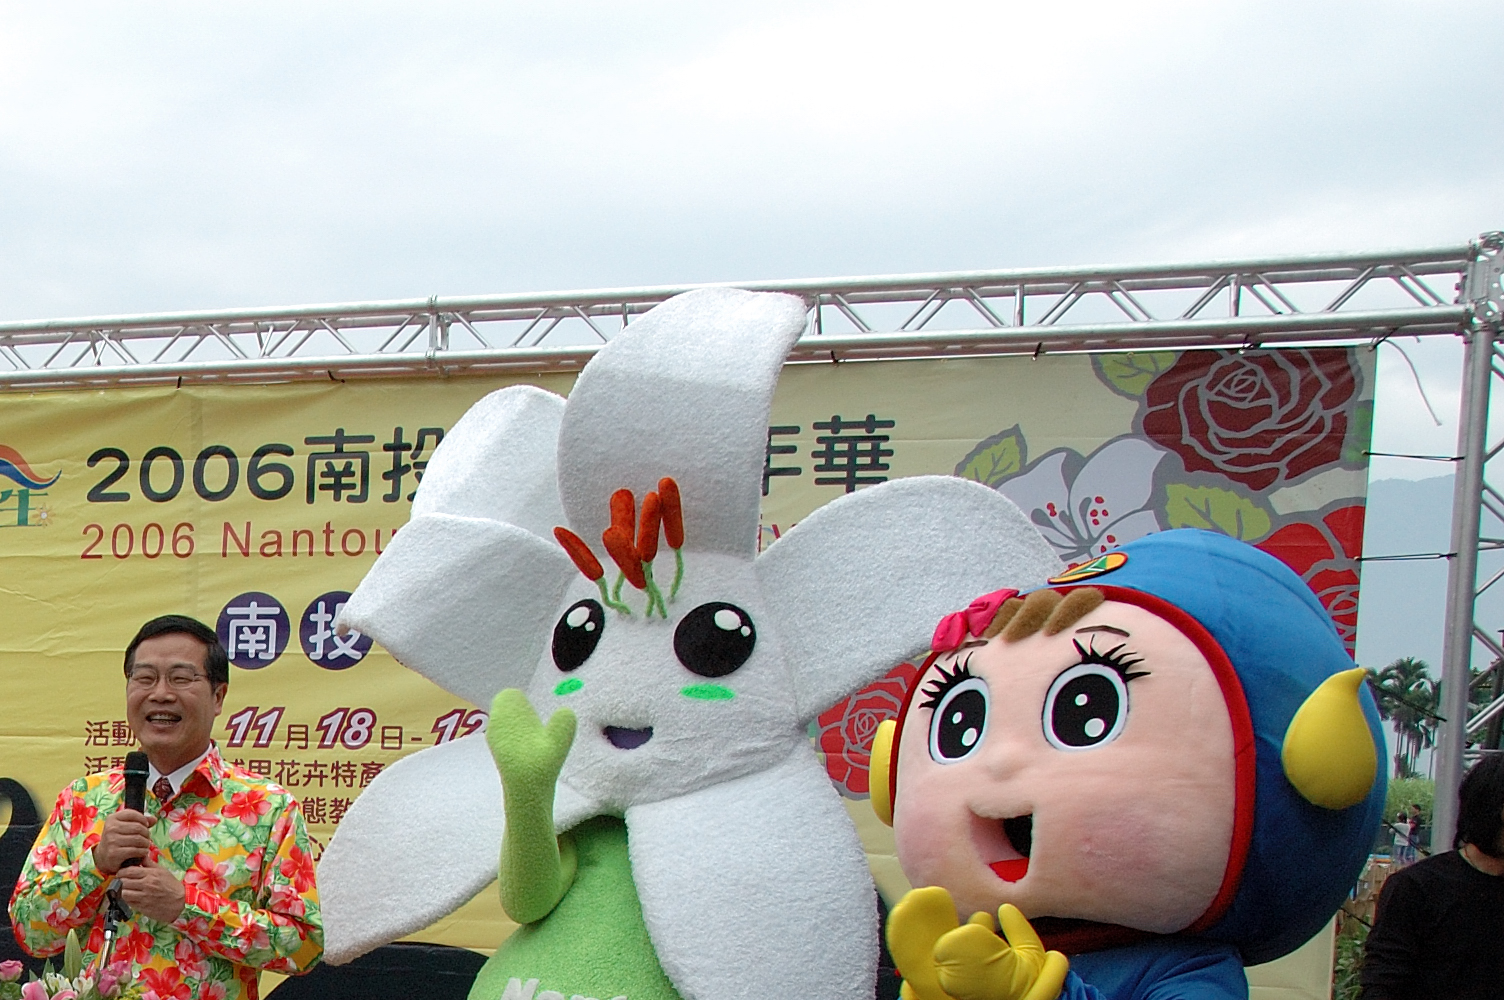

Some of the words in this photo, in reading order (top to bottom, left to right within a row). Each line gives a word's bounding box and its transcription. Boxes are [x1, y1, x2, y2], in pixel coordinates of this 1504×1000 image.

[85, 427, 445, 504] 2006南投
[80, 522, 196, 560] 2006
[226, 600, 364, 661] 南投
[84, 720, 137, 747] 活動
[224, 758, 386, 788] 里花卉特產
